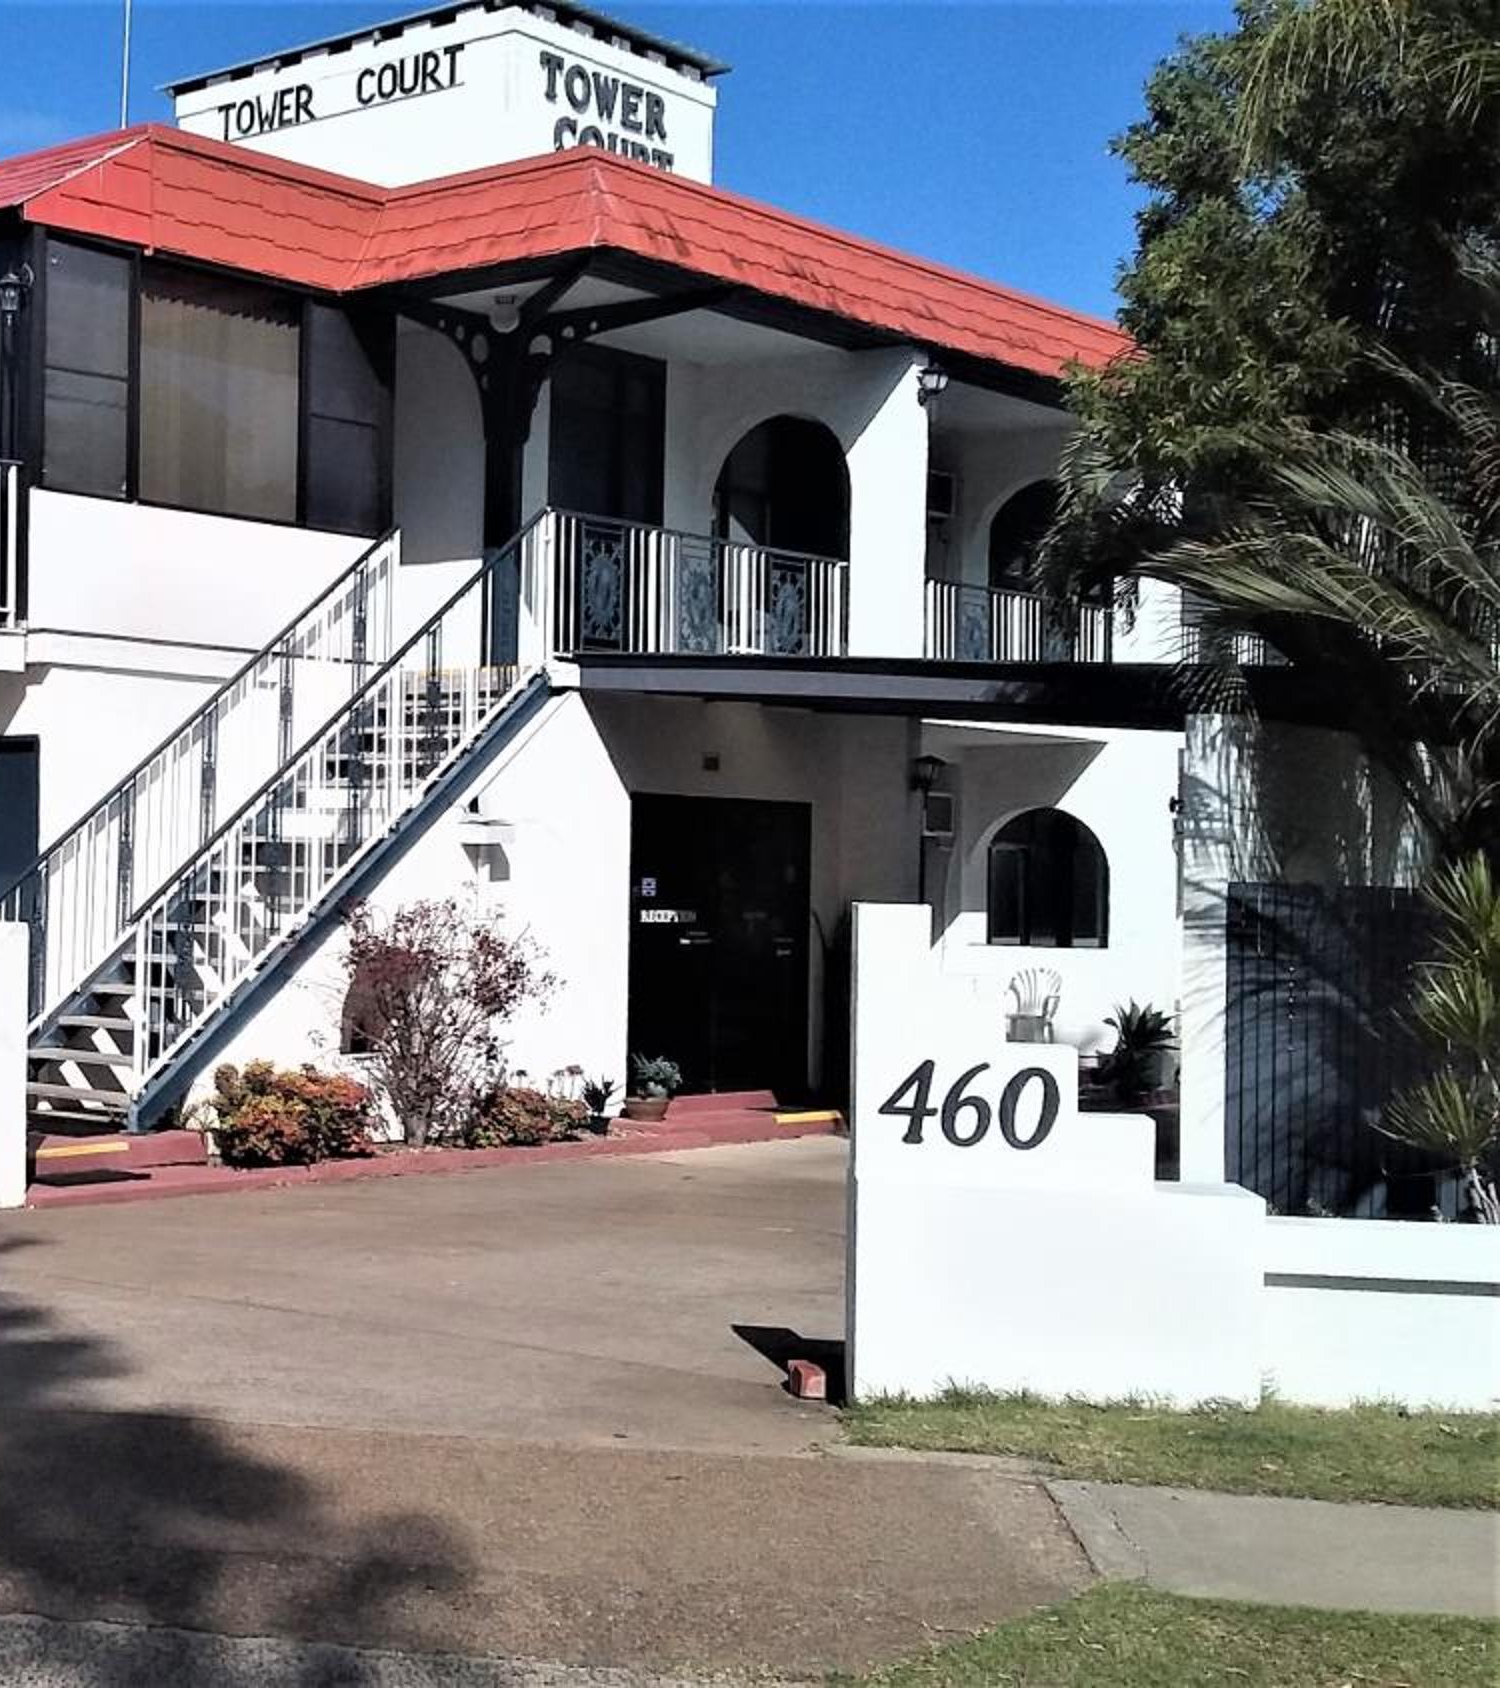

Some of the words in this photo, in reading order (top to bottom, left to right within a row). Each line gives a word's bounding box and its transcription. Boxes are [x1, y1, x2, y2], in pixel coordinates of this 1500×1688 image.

[218, 83, 316, 141] TOWER
[357, 43, 465, 104] COURT
[540, 50, 667, 142] TOWER
[878, 1059, 1060, 1150] 460
